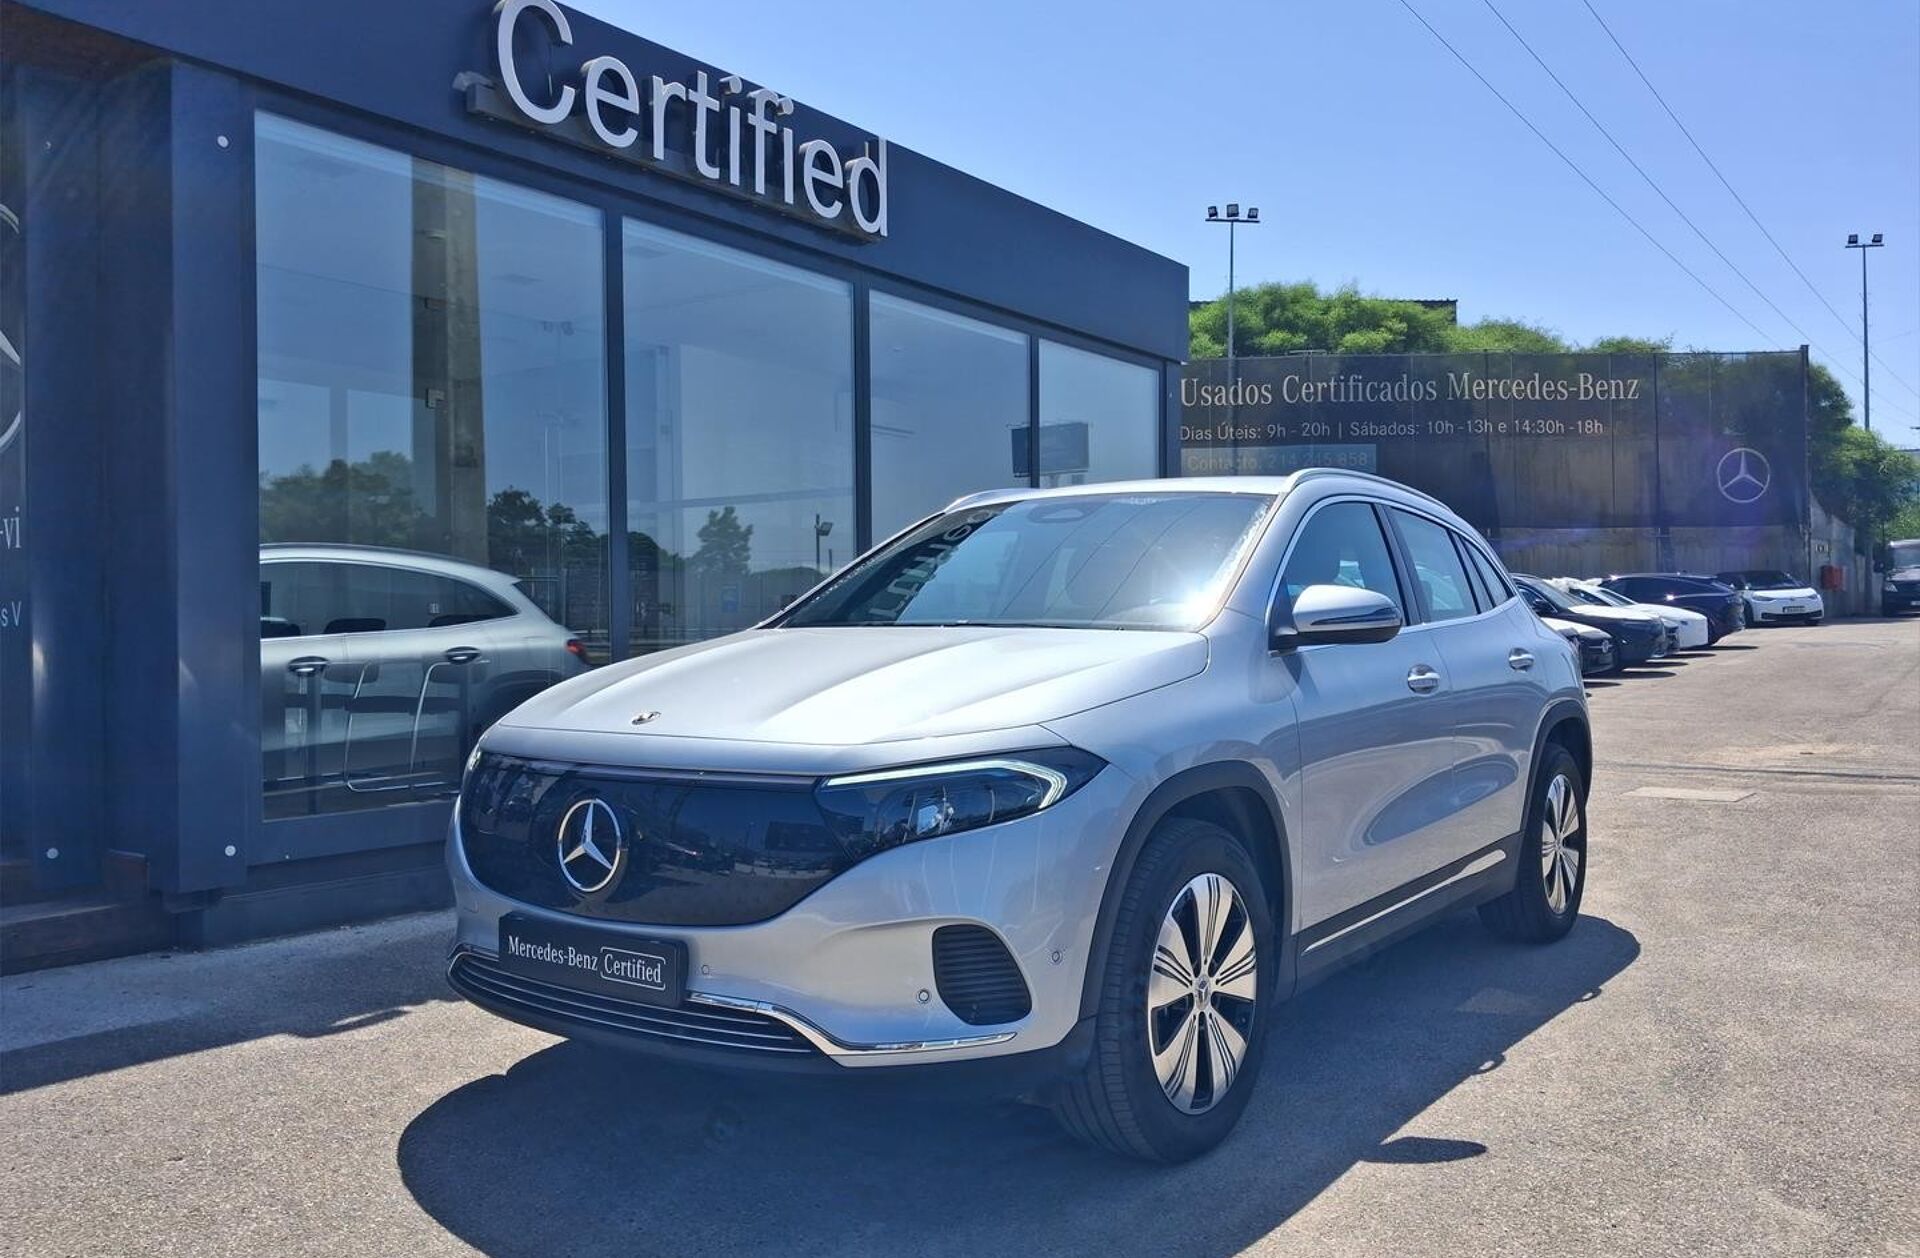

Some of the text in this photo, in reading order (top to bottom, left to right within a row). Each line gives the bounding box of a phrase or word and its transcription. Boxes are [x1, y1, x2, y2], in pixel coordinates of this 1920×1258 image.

[495, 0, 888, 237] Certified
[1180, 372, 1640, 406] Usados Certificados Mercedes-Benz
[1179, 425, 1212, 441] Dias
[1216, 421, 1262, 441] Úteis:
[1267, 424, 1286, 438] 9h
[1302, 422, 1330, 437] 20h
[1350, 421, 1420, 437] Sábados:
[1427, 419, 1454, 435] 10h
[1498, 422, 1507, 433] e
[1514, 419, 1565, 435] 14:30h
[508, 934, 662, 984] Mercedes-Benz Certified
